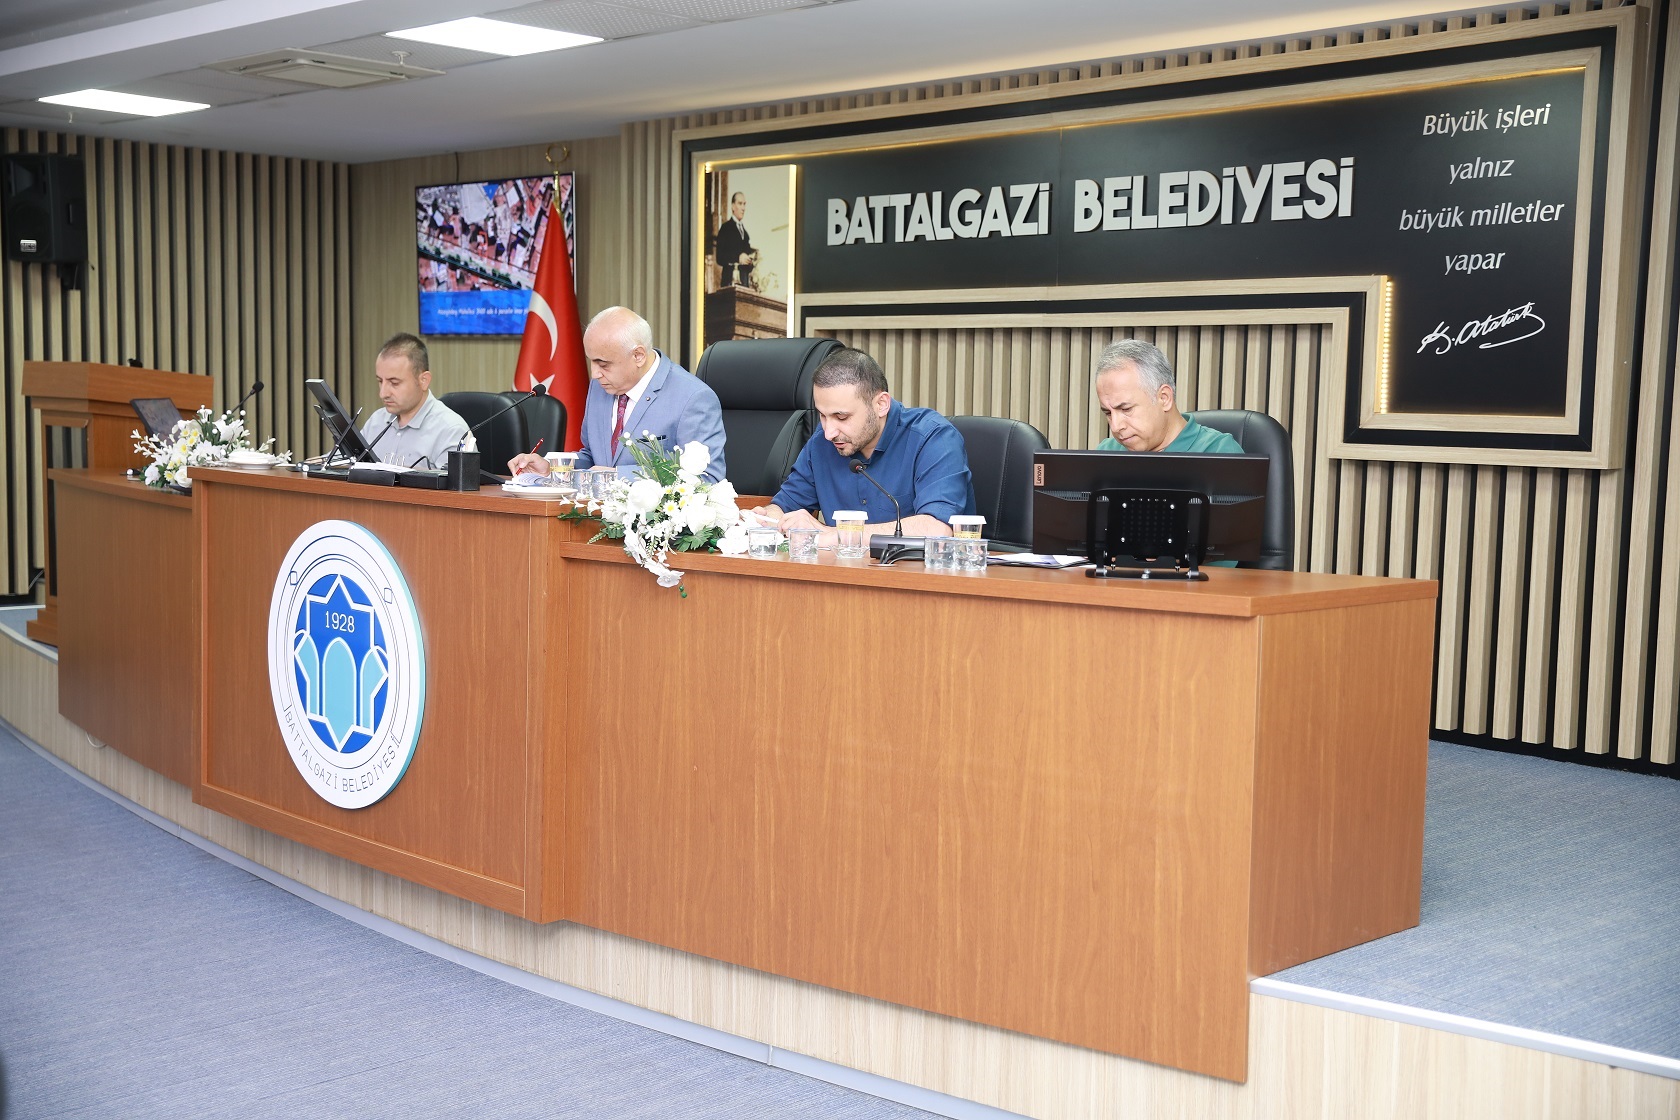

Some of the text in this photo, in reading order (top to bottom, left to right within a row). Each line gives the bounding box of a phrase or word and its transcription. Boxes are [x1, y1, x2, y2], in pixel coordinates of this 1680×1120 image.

[1422, 103, 1551, 137] Büyük işleri
[1449, 156, 1515, 185] yalnız
[826, 181, 1052, 247] BATTALGAZİ
[1398, 199, 1565, 234] büyük milletler
[1444, 251, 1506, 276] yapar
[324, 610, 356, 634] 1928
[283, 709, 400, 793] BATTALGAZİ BELEDİYESİ
